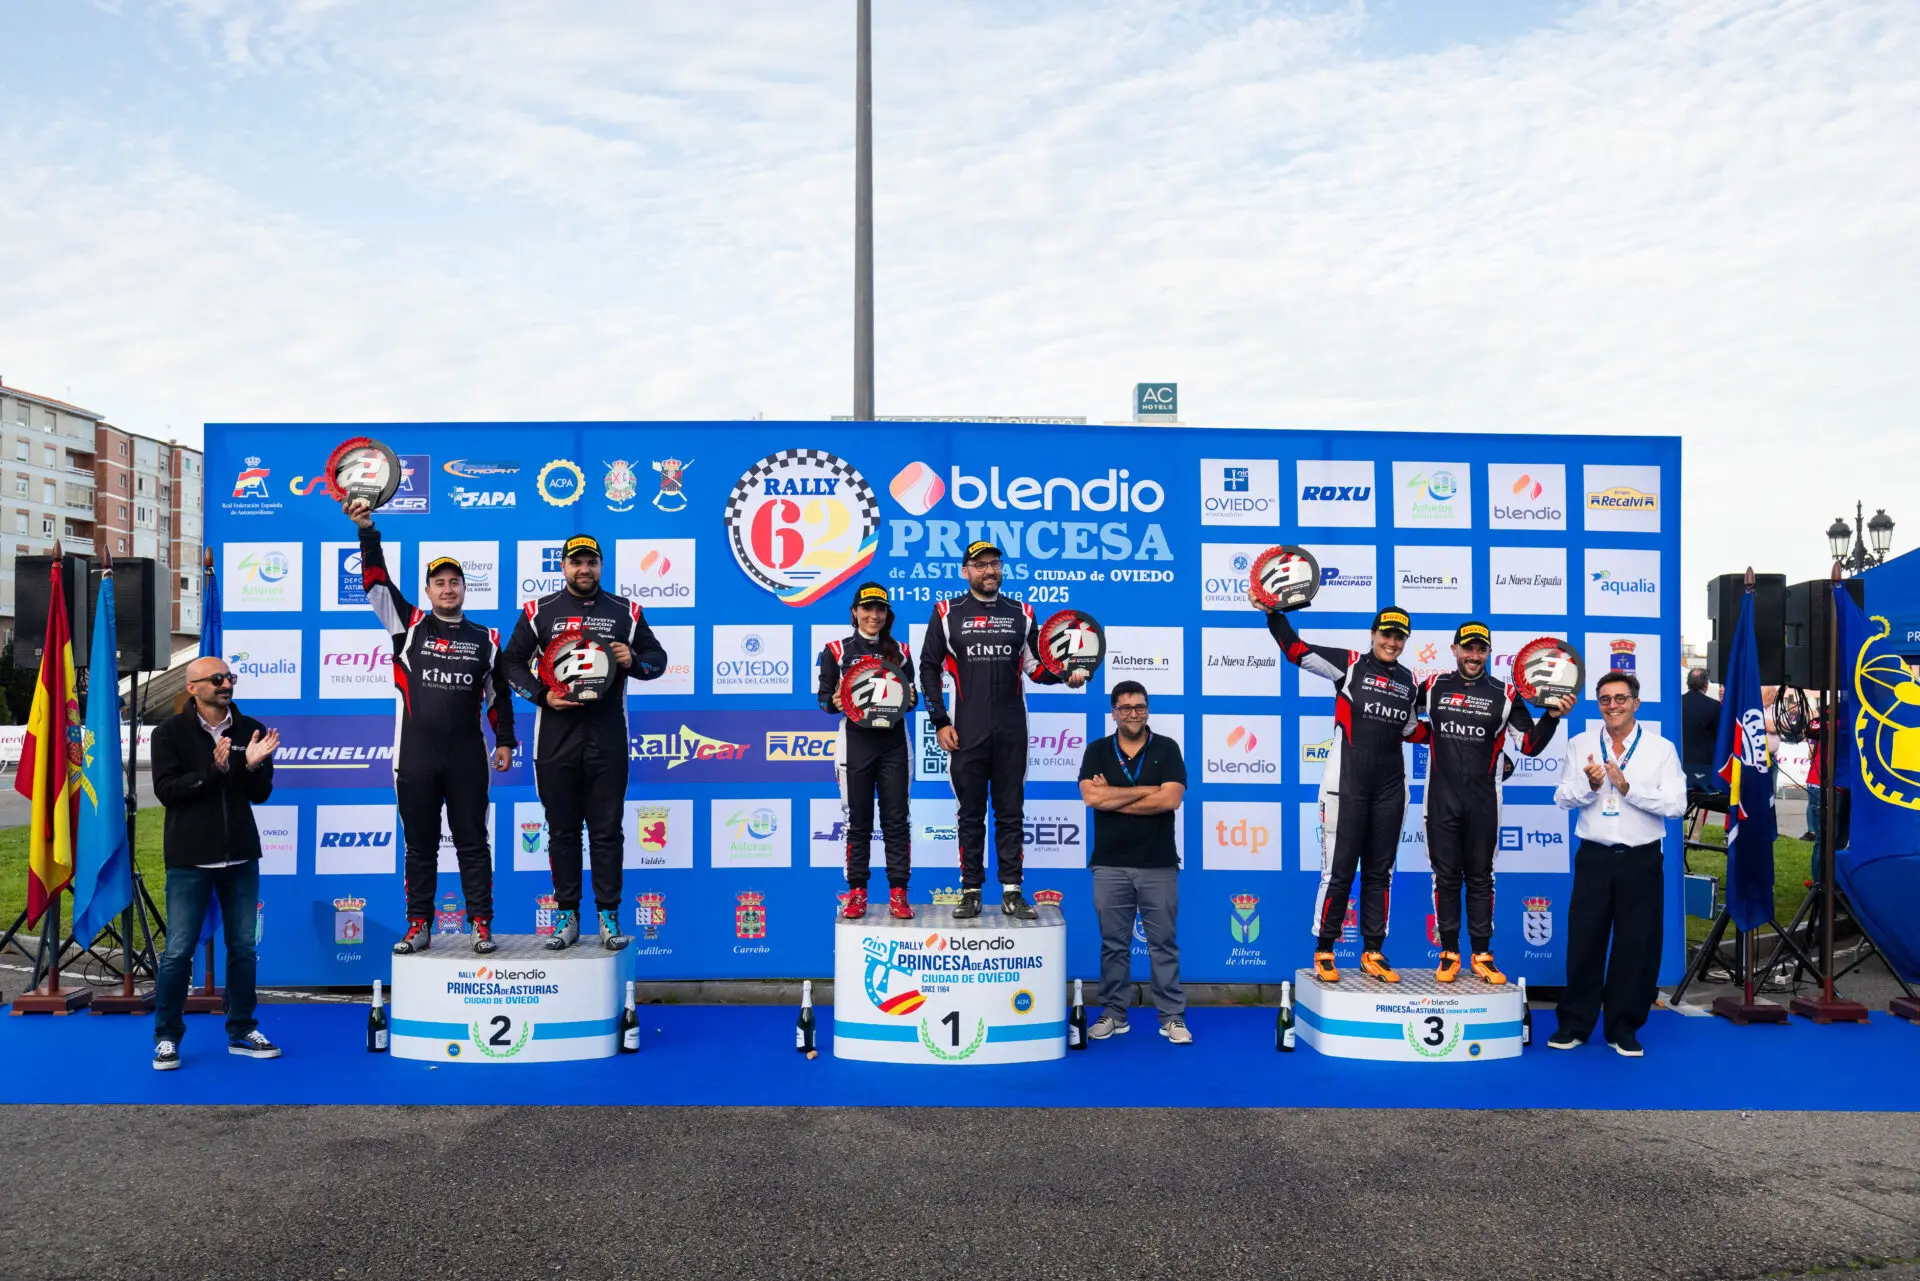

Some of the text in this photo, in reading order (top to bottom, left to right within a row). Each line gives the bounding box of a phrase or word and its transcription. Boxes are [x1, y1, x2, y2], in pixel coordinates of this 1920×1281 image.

[1142, 387, 1173, 403] AC
[550, 478, 574, 488] ACPA
[763, 478, 840, 496] RALLY
[951, 465, 1165, 513] blendio
[1302, 486, 1371, 501] ROXU
[1205, 497, 1269, 512] OVIEDO
[1601, 496, 1644, 507] Recalvi
[1494, 506, 1562, 520] blendio
[751, 498, 852, 570] 62
[888, 519, 1174, 561] PRINCESA
[461, 561, 493, 571] Ribera
[889, 562, 1174, 583] de ASTUAS CIUDAD de OVIEDO
[1205, 578, 1250, 594] OVIE
[1496, 574, 1562, 587] La Nueva España
[1601, 578, 1655, 596] aqualia
[620, 583, 689, 599] blendio
[889, 587, 931, 602] 11-13
[1028, 586, 1070, 603] 2025
[553, 621, 580, 631] GR
[963, 620, 986, 628] GR
[424, 640, 448, 653] GR
[323, 645, 393, 673] renfe
[1207, 655, 1276, 668] La Nueva España
[239, 660, 296, 678] aqualia
[716, 660, 789, 676] OVIEDO
[331, 675, 388, 684] TREN OFICIAL
[1364, 676, 1387, 689] GR
[1440, 696, 1462, 706] GR
[1029, 728, 1083, 755] enfe
[274, 746, 394, 761] MICHELIN
[1043, 757, 1076, 766] OFICIAL
[1207, 759, 1277, 774] blendio
[320, 831, 392, 848] ROXU
[1215, 819, 1269, 854] tdp
[1527, 830, 1563, 847] rtpa
[640, 857, 666, 865] Valdés
[733, 945, 770, 955] Carreño
[899, 936, 1015, 951] RALLY blendio
[336, 952, 362, 962] Gijón
[1231, 948, 1261, 957] Ribera
[1524, 949, 1552, 959] Pravia
[898, 954, 1042, 971] PRINCESA DE ASTURIAS
[1226, 957, 1267, 966] de Arriba
[458, 968, 546, 980] RALLY blendio
[921, 972, 1020, 984] CIUDAD DE OVIEDO
[447, 983, 501, 996] PRINCESA
[509, 984, 559, 995] ASTURIAS
[921, 985, 950, 993] SINCE 1964
[463, 995, 539, 1005] CIUDAD DE OVIEDO
[1376, 1004, 1411, 1014] PRINCESA
[489, 1015, 511, 1046] 2
[941, 1011, 960, 1047] 1
[1423, 1015, 1445, 1047] 3
